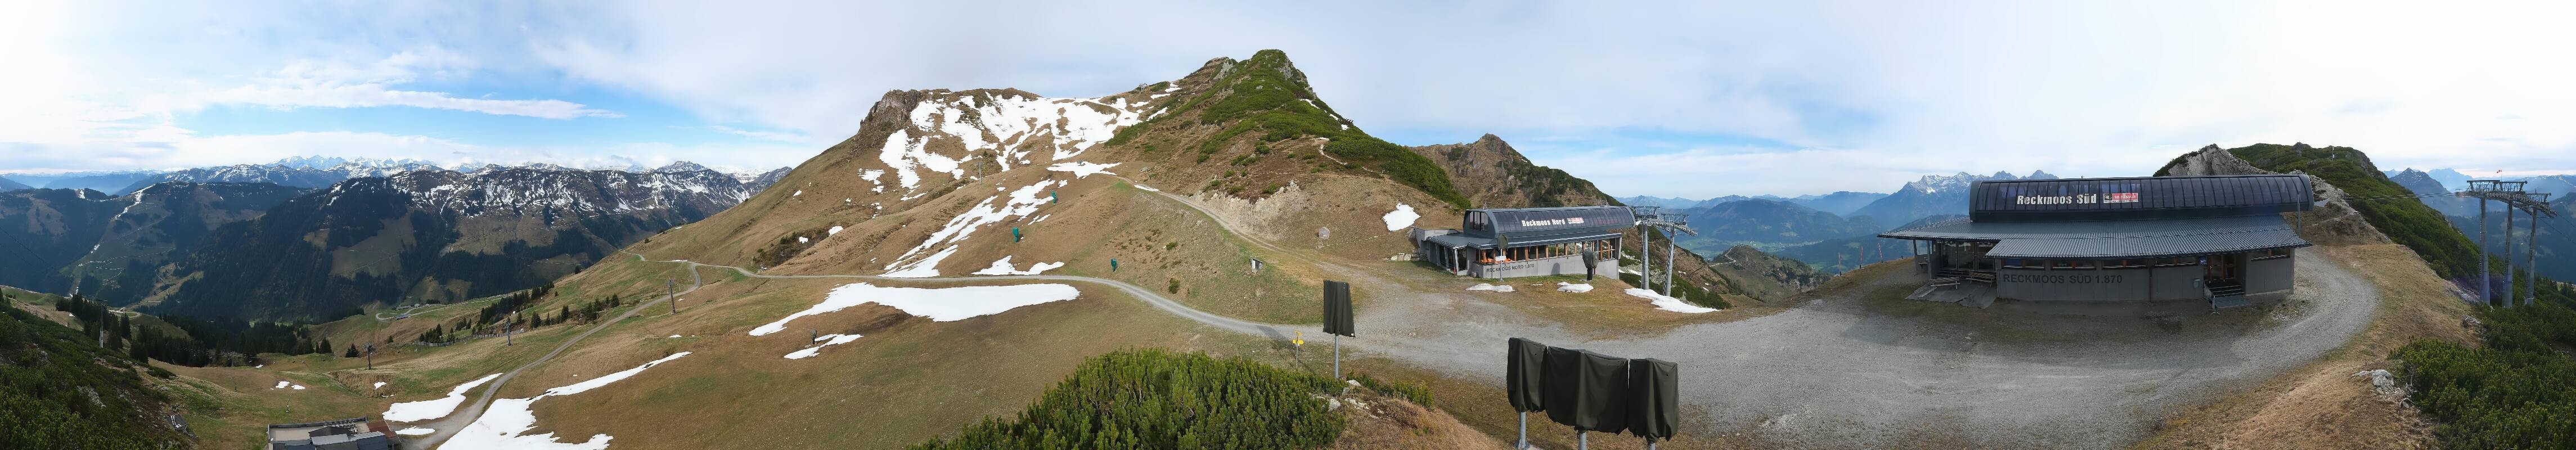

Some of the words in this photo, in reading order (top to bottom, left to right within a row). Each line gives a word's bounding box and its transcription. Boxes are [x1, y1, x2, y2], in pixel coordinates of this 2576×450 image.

[2017, 195, 2073, 205] Reckmoos
[2076, 194, 2097, 204] Süd
[2003, 274, 2065, 284] RECKMOOS
[2069, 274, 2092, 284] SÜD
[2095, 274, 2123, 284] 1.870
